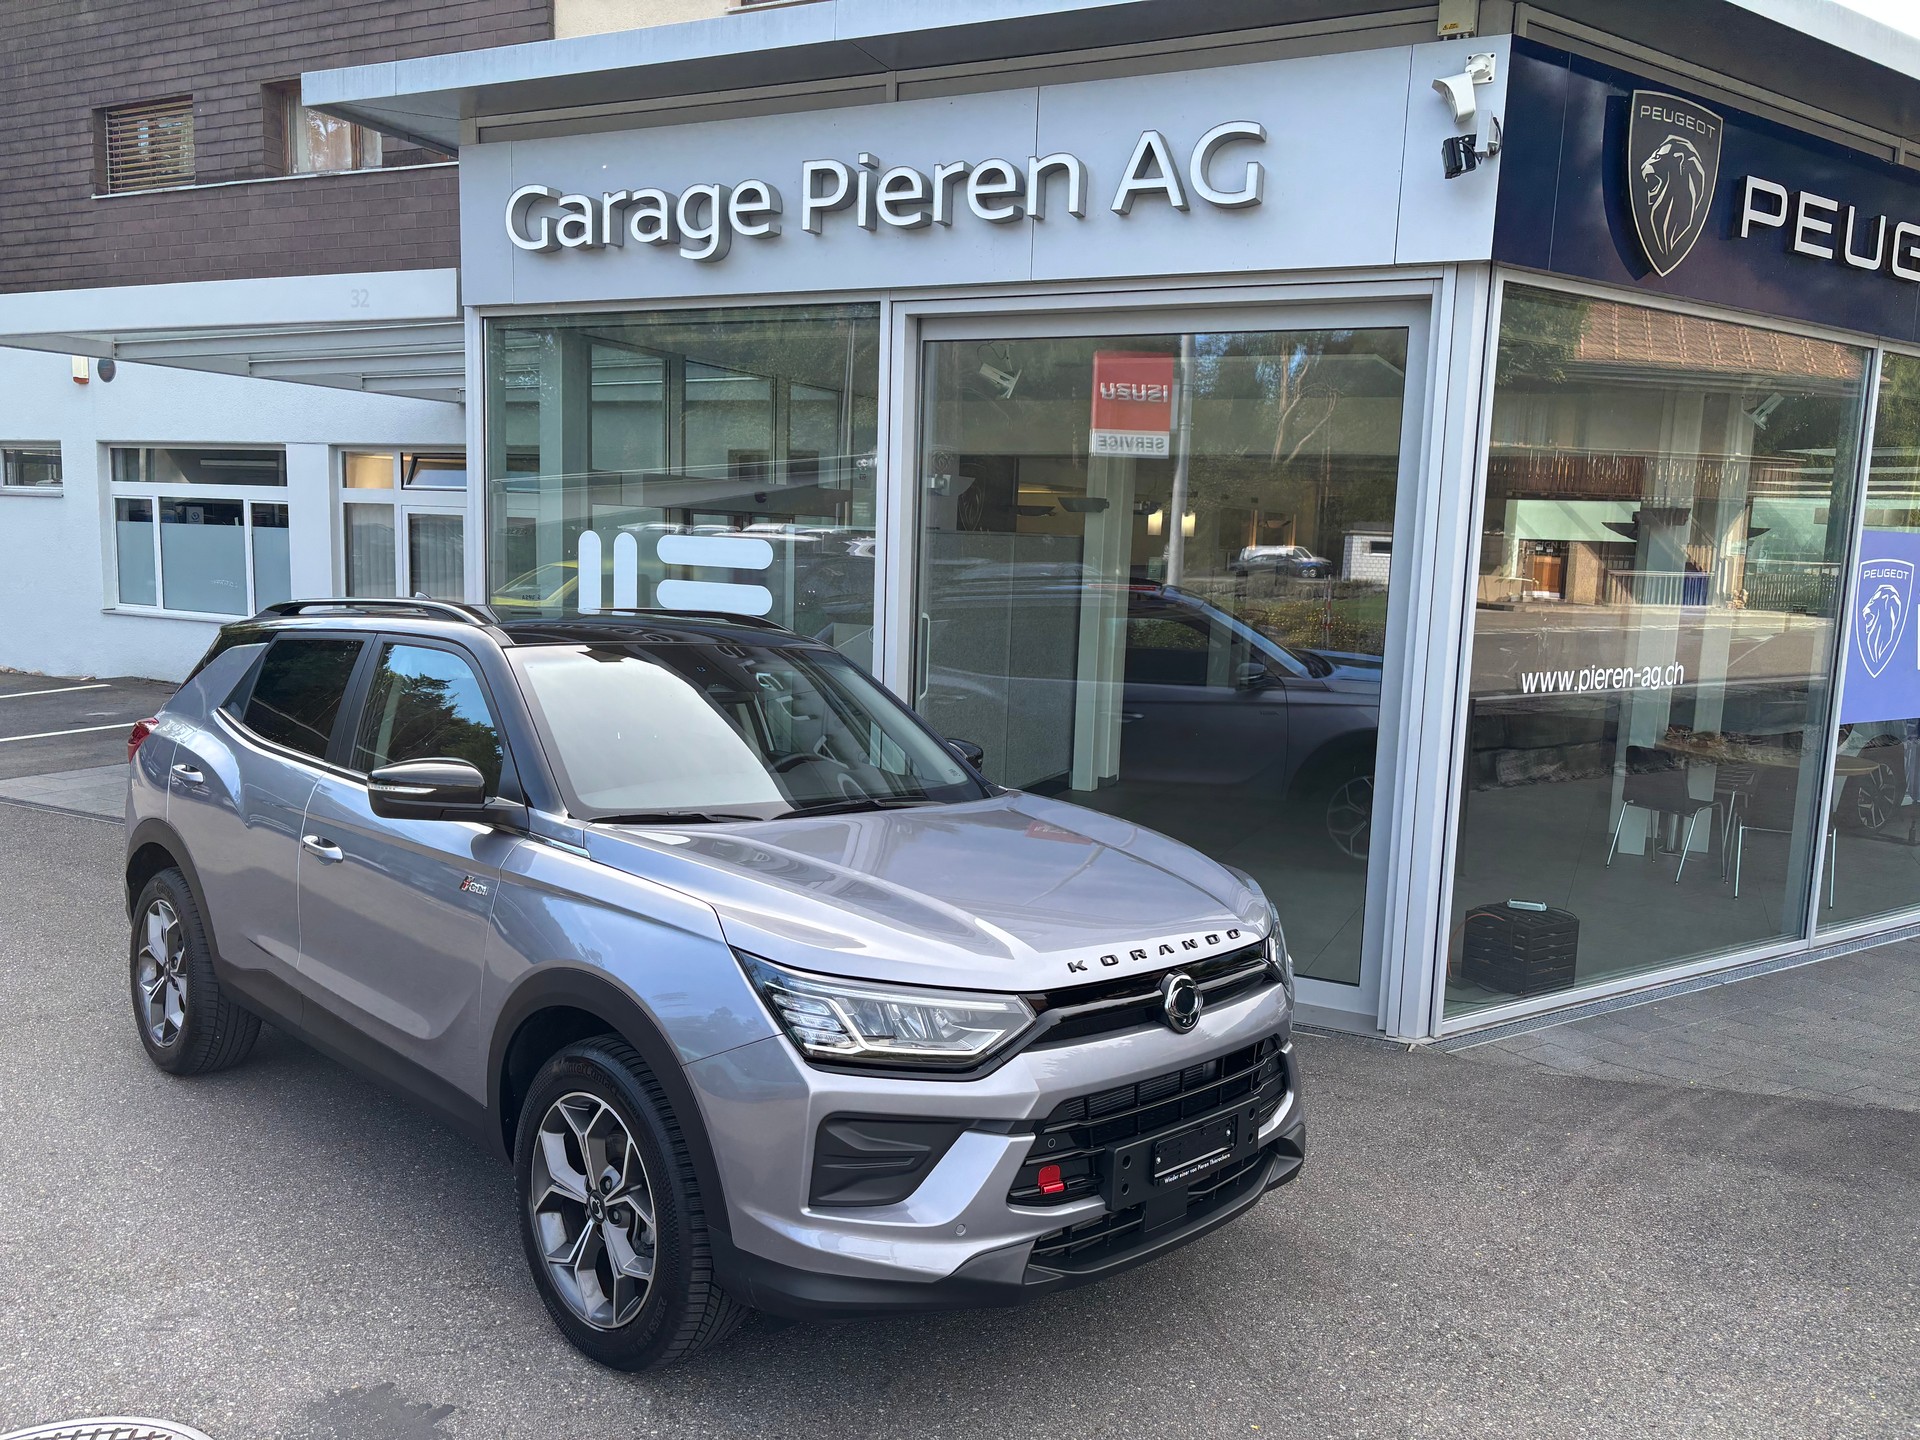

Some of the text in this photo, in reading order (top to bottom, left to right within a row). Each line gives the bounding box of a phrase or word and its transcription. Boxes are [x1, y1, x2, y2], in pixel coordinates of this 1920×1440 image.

[1640, 105, 1716, 138] PEUGEOT
[504, 120, 1267, 262] Garage Pieren AG
[1741, 175, 1920, 282] PEUG
[351, 288, 370, 308] 32
[1863, 568, 1910, 580] PEUGEOT
[1521, 661, 1685, 694] www.pieren-ag.ch
[1067, 928, 1241, 973] KORANDO
